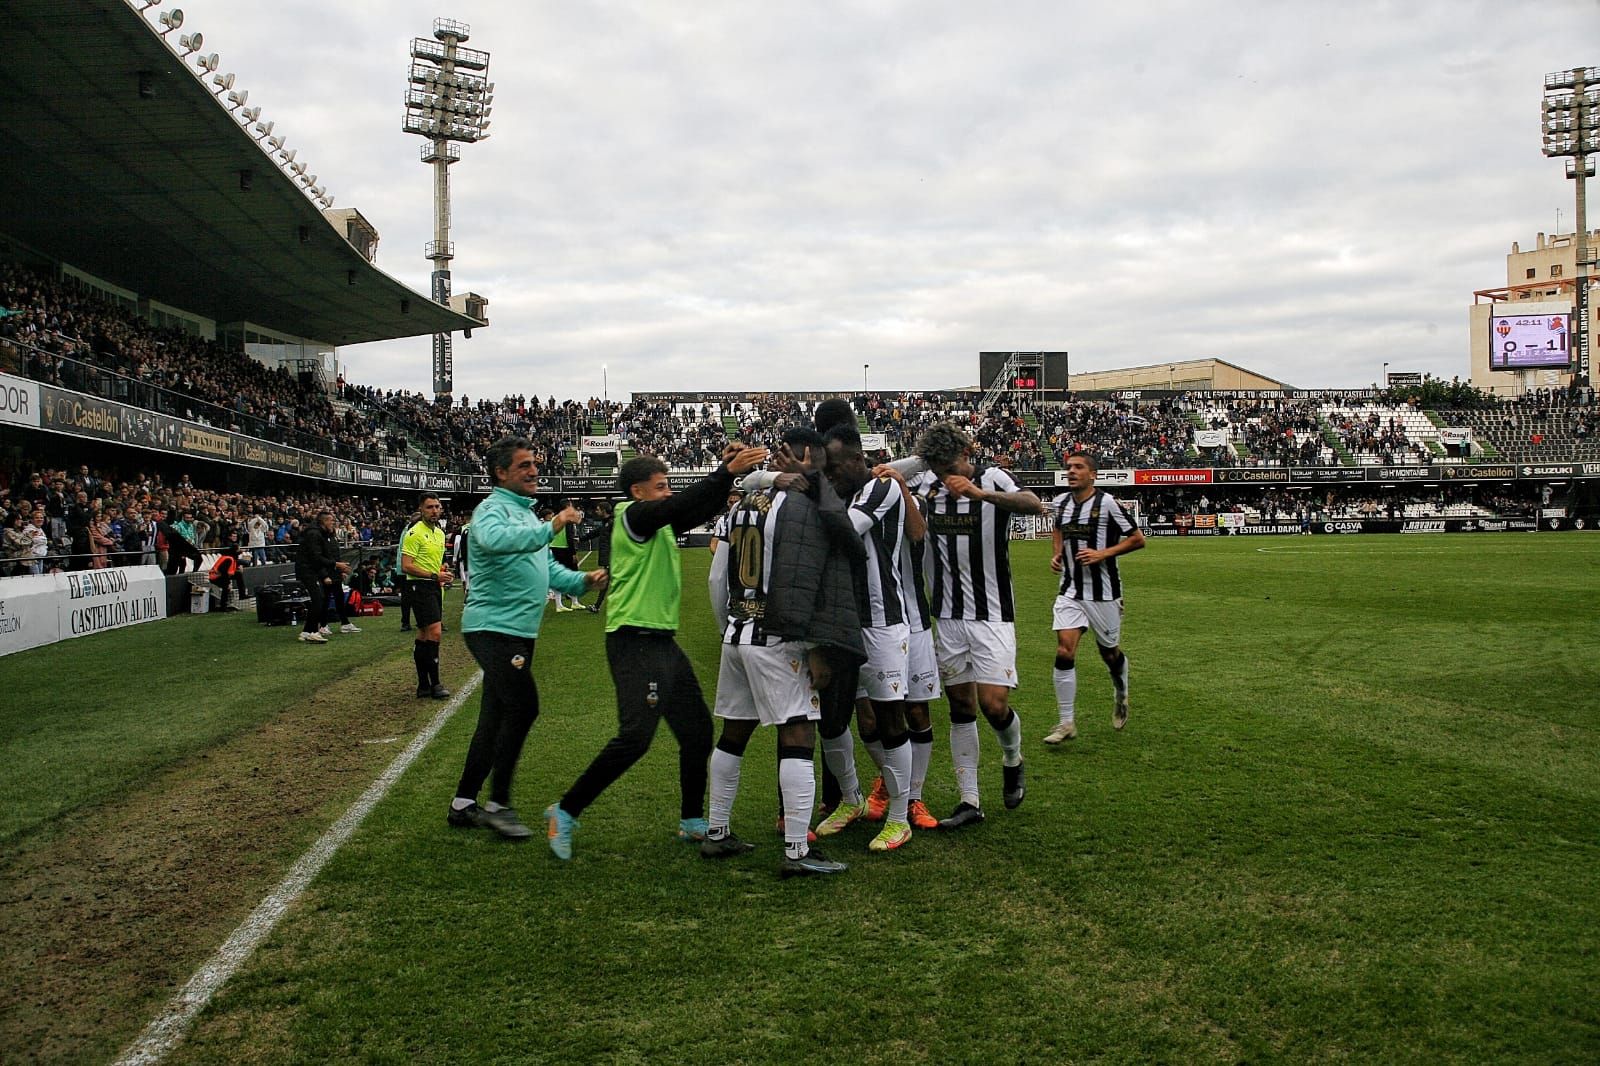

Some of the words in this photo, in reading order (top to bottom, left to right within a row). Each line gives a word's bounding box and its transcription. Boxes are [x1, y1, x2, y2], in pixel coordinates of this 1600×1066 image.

[1580, 308, 1588, 331] DAMM
[1504, 341, 1516, 352] 0
[1547, 340, 1558, 350] 1
[1580, 334, 1588, 367] ESTRELLA
[730, 526, 760, 588] 10
[67, 576, 84, 600] EL
[90, 570, 128, 596] MUNDO
[71, 596, 128, 634] CASTELLÓN
[130, 602, 142, 623] AL
[144, 591, 158, 619] DÍA
